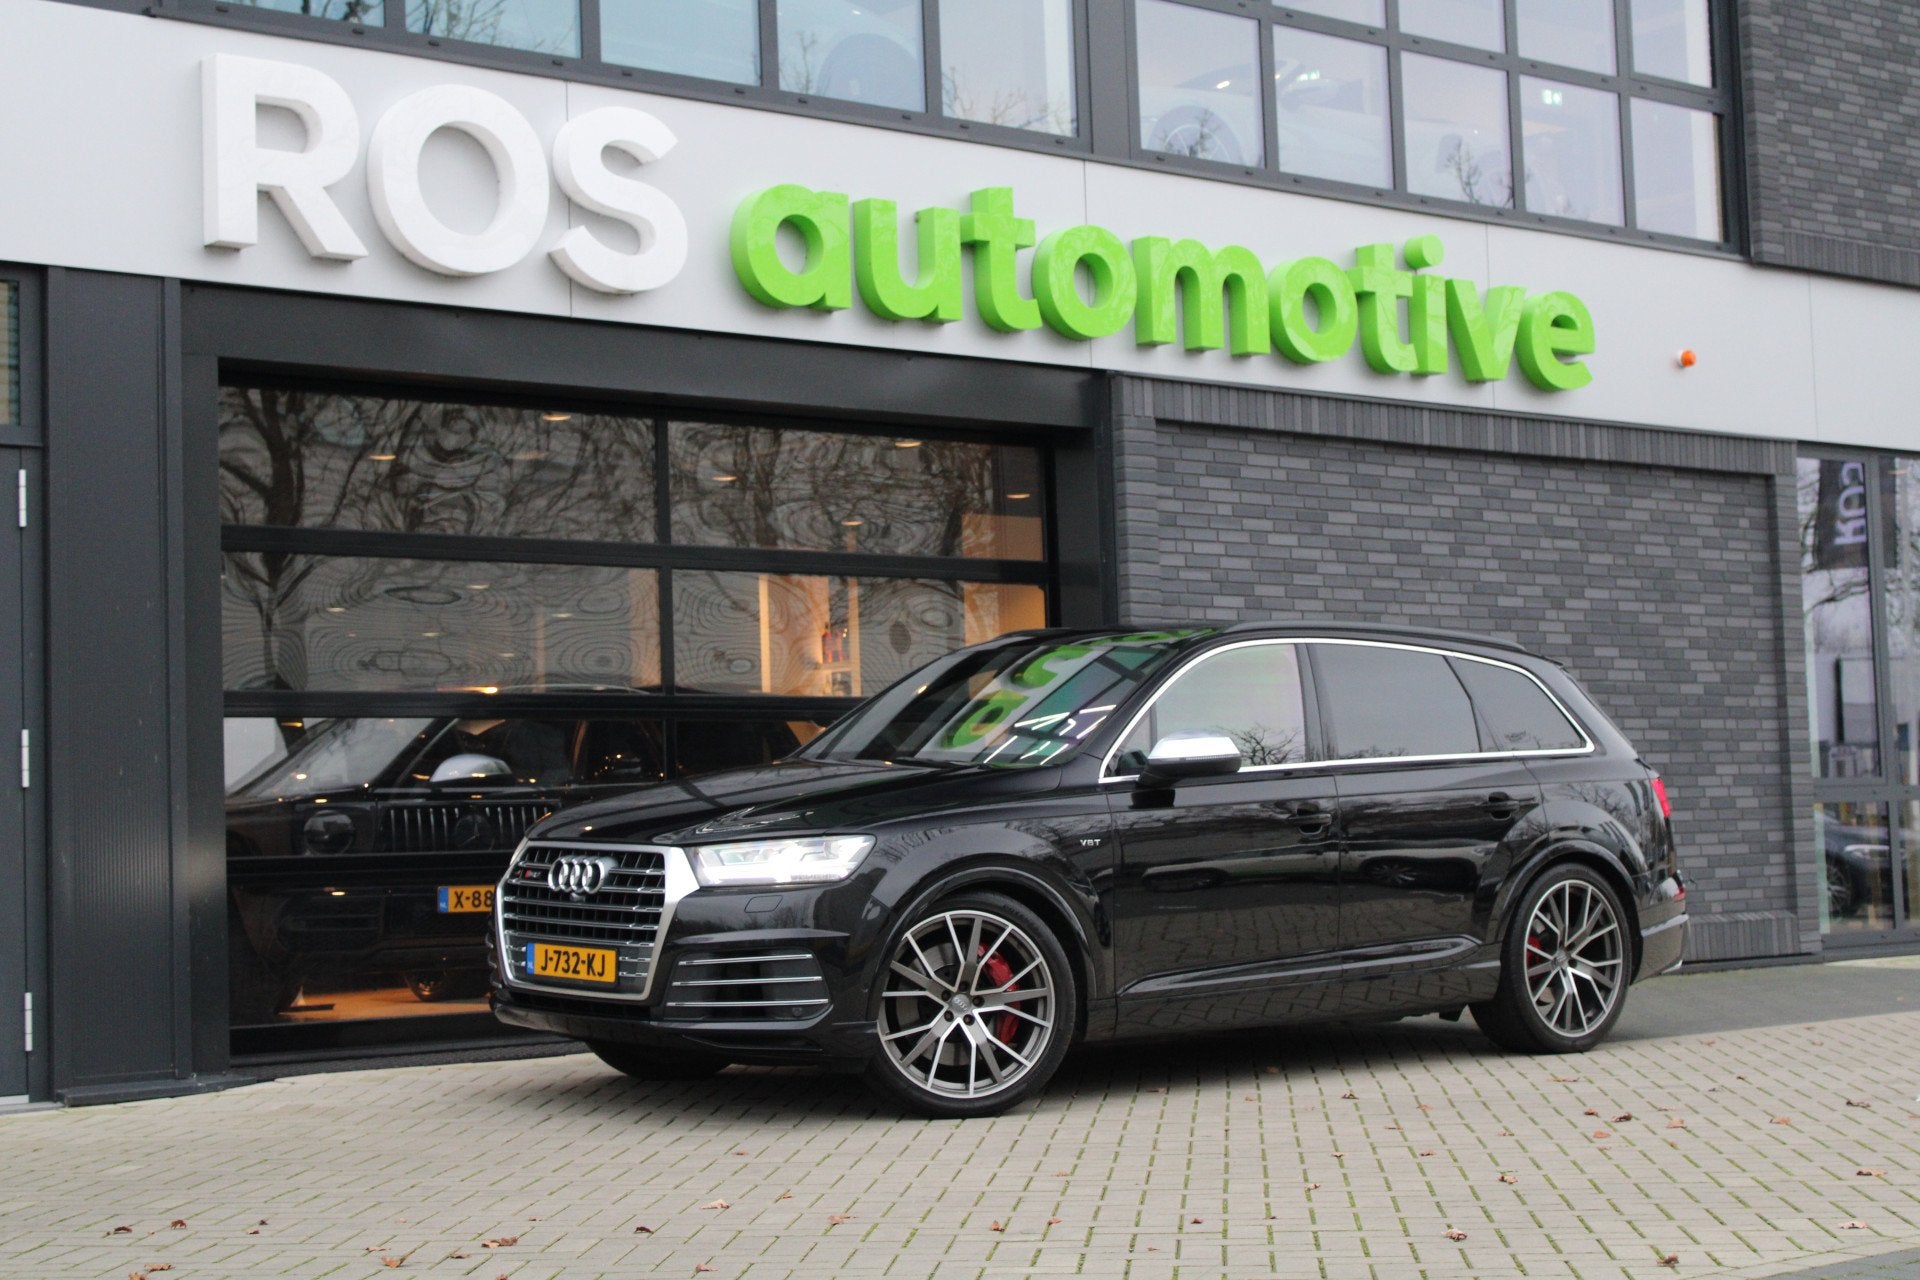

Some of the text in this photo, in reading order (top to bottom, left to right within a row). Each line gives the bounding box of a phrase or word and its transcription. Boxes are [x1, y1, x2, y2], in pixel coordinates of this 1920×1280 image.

[200, 53, 1595, 392] ROS automotive
[541, 948, 605, 977] J-732-KJ
